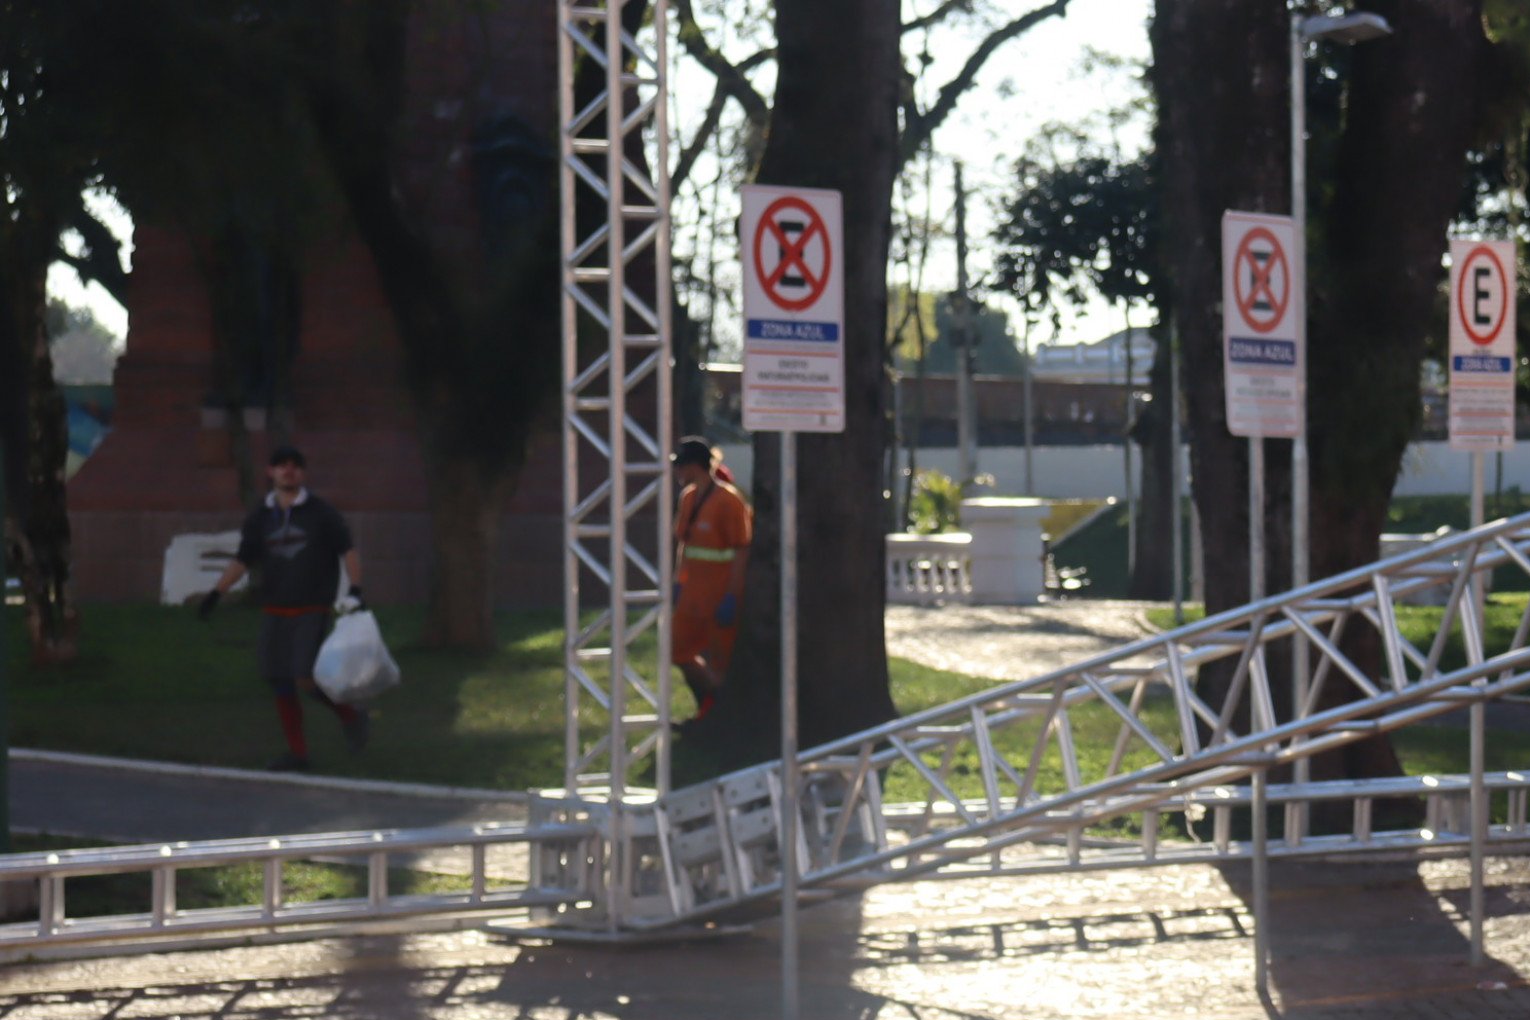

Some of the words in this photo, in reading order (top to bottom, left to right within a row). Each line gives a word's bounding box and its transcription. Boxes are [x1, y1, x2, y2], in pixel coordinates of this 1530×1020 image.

[1474, 267, 1491, 324] E
[761, 322, 793, 337] ZONA
[794, 324, 824, 340] AZUL
[1231, 341, 1262, 358] ZONA
[1264, 344, 1294, 361] AZUL
